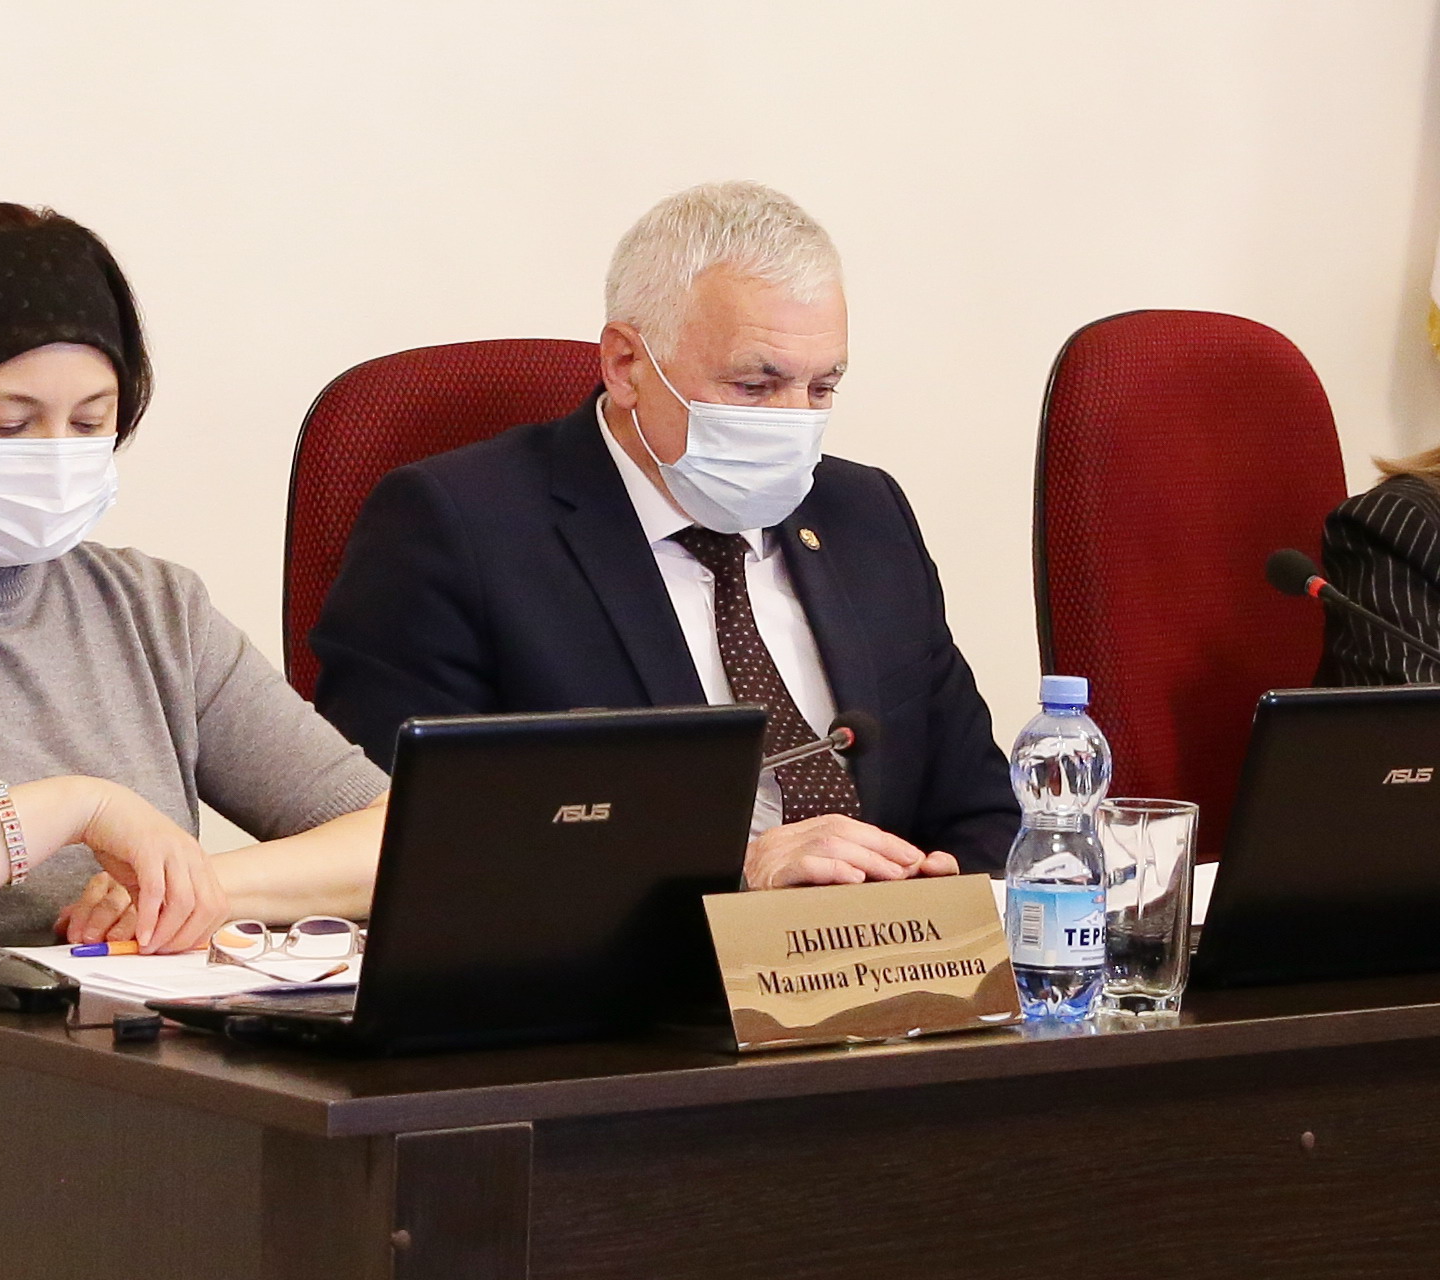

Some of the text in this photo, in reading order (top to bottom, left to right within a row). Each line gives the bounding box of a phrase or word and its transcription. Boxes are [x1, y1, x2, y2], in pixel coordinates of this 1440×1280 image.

[1382, 767, 1434, 785] ASUS
[551, 802, 612, 823] ASUS
[784, 917, 943, 960] ДЫШЕКОВА
[756, 956, 987, 997] Мадина Руслановна
